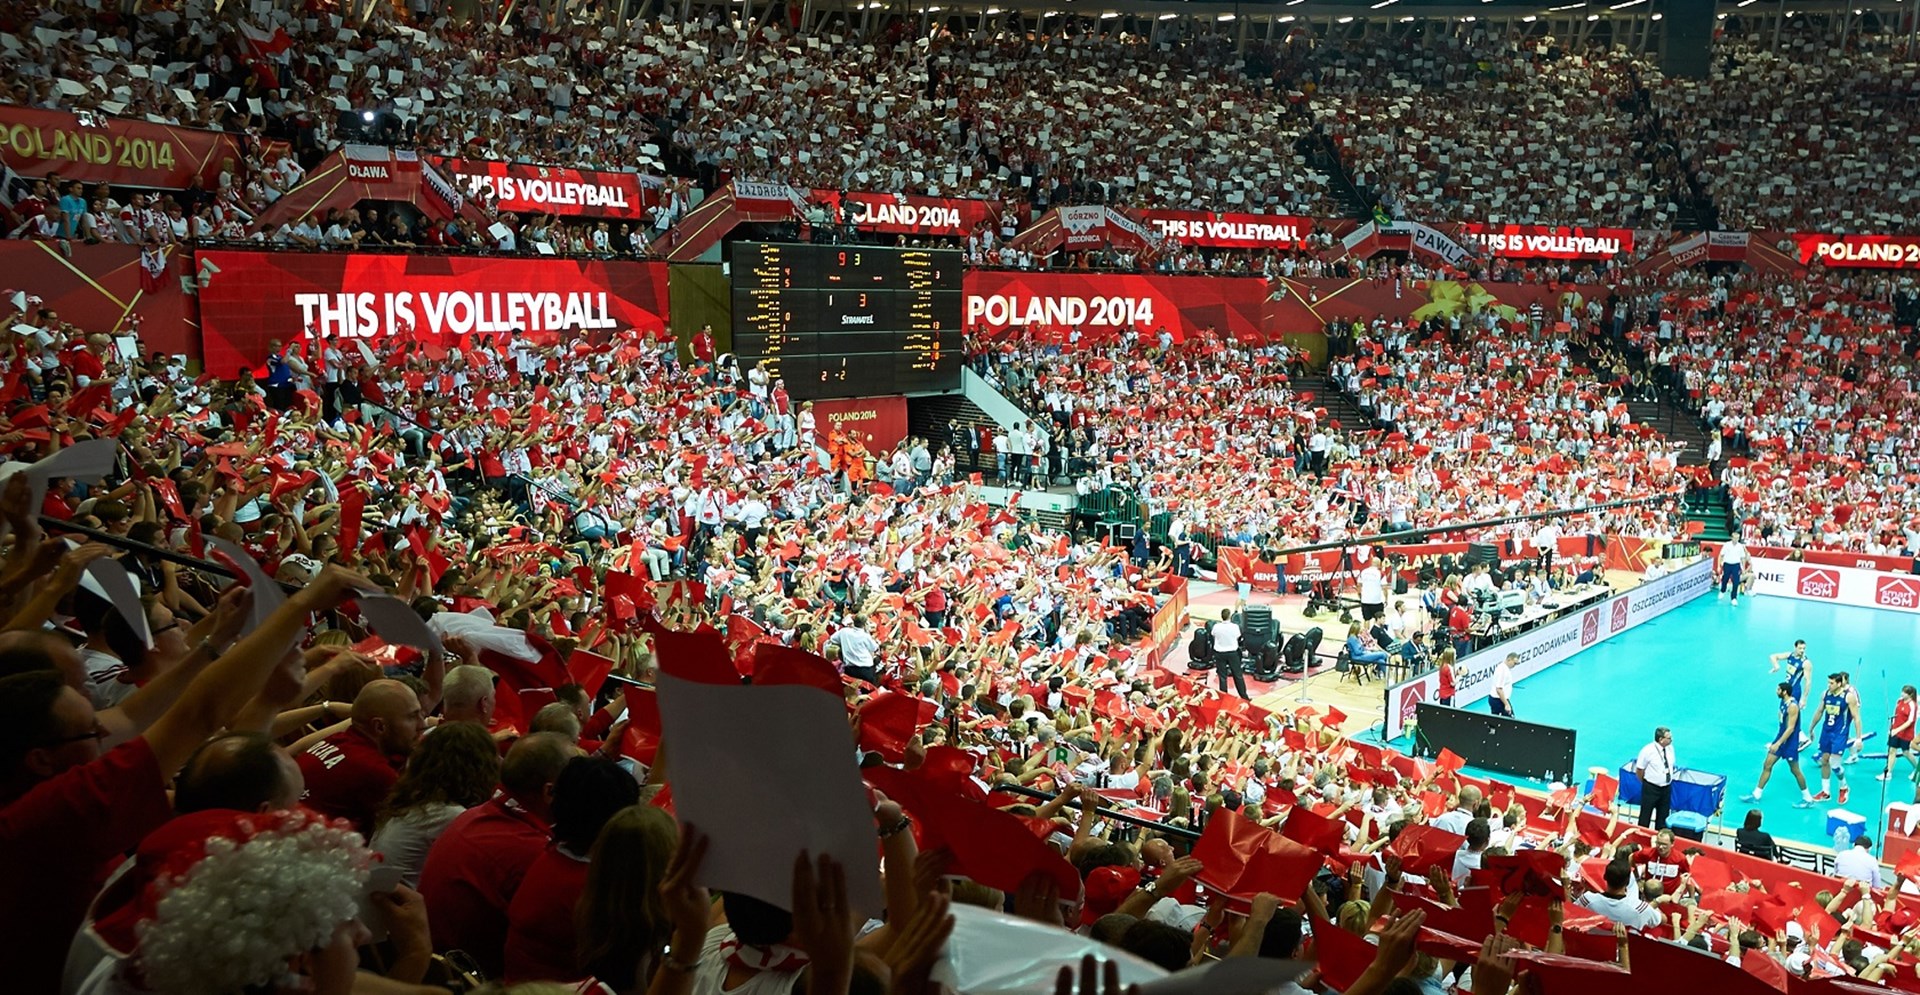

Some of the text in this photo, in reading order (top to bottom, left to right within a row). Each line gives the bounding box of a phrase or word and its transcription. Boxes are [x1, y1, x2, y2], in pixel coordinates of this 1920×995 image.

[114, 135, 175, 171] 2014
[497, 176, 515, 200] IS
[517, 177, 629, 208] VOLLEYBALL
[852, 201, 961, 228] OLAND 2014
[1068, 209, 1099, 220] GÓRZNO
[1189, 221, 1204, 238] IS
[1206, 221, 1301, 242] VOLLEYBALL
[1509, 234, 1524, 251] IS
[838, 252, 860, 266] 9 3
[1817, 242, 1920, 262] POLAND 2
[294, 290, 618, 339] THIS IS VOLLEYBALL
[967, 294, 1154, 326] POLAND 2014
[828, 410, 877, 423] POLAND 2014
[1856, 559, 1876, 568] FIVB
[1755, 572, 1785, 583] NIE
[1802, 587, 1833, 597] DOM
[1803, 580, 1833, 590] smart
[1880, 596, 1913, 607] DOM
[1882, 590, 1913, 599] smart
[1432, 661, 1500, 702] OZĘDZAN
[1532, 628, 1578, 658] DODAWANIE
[1827, 714, 1835, 726] 5
